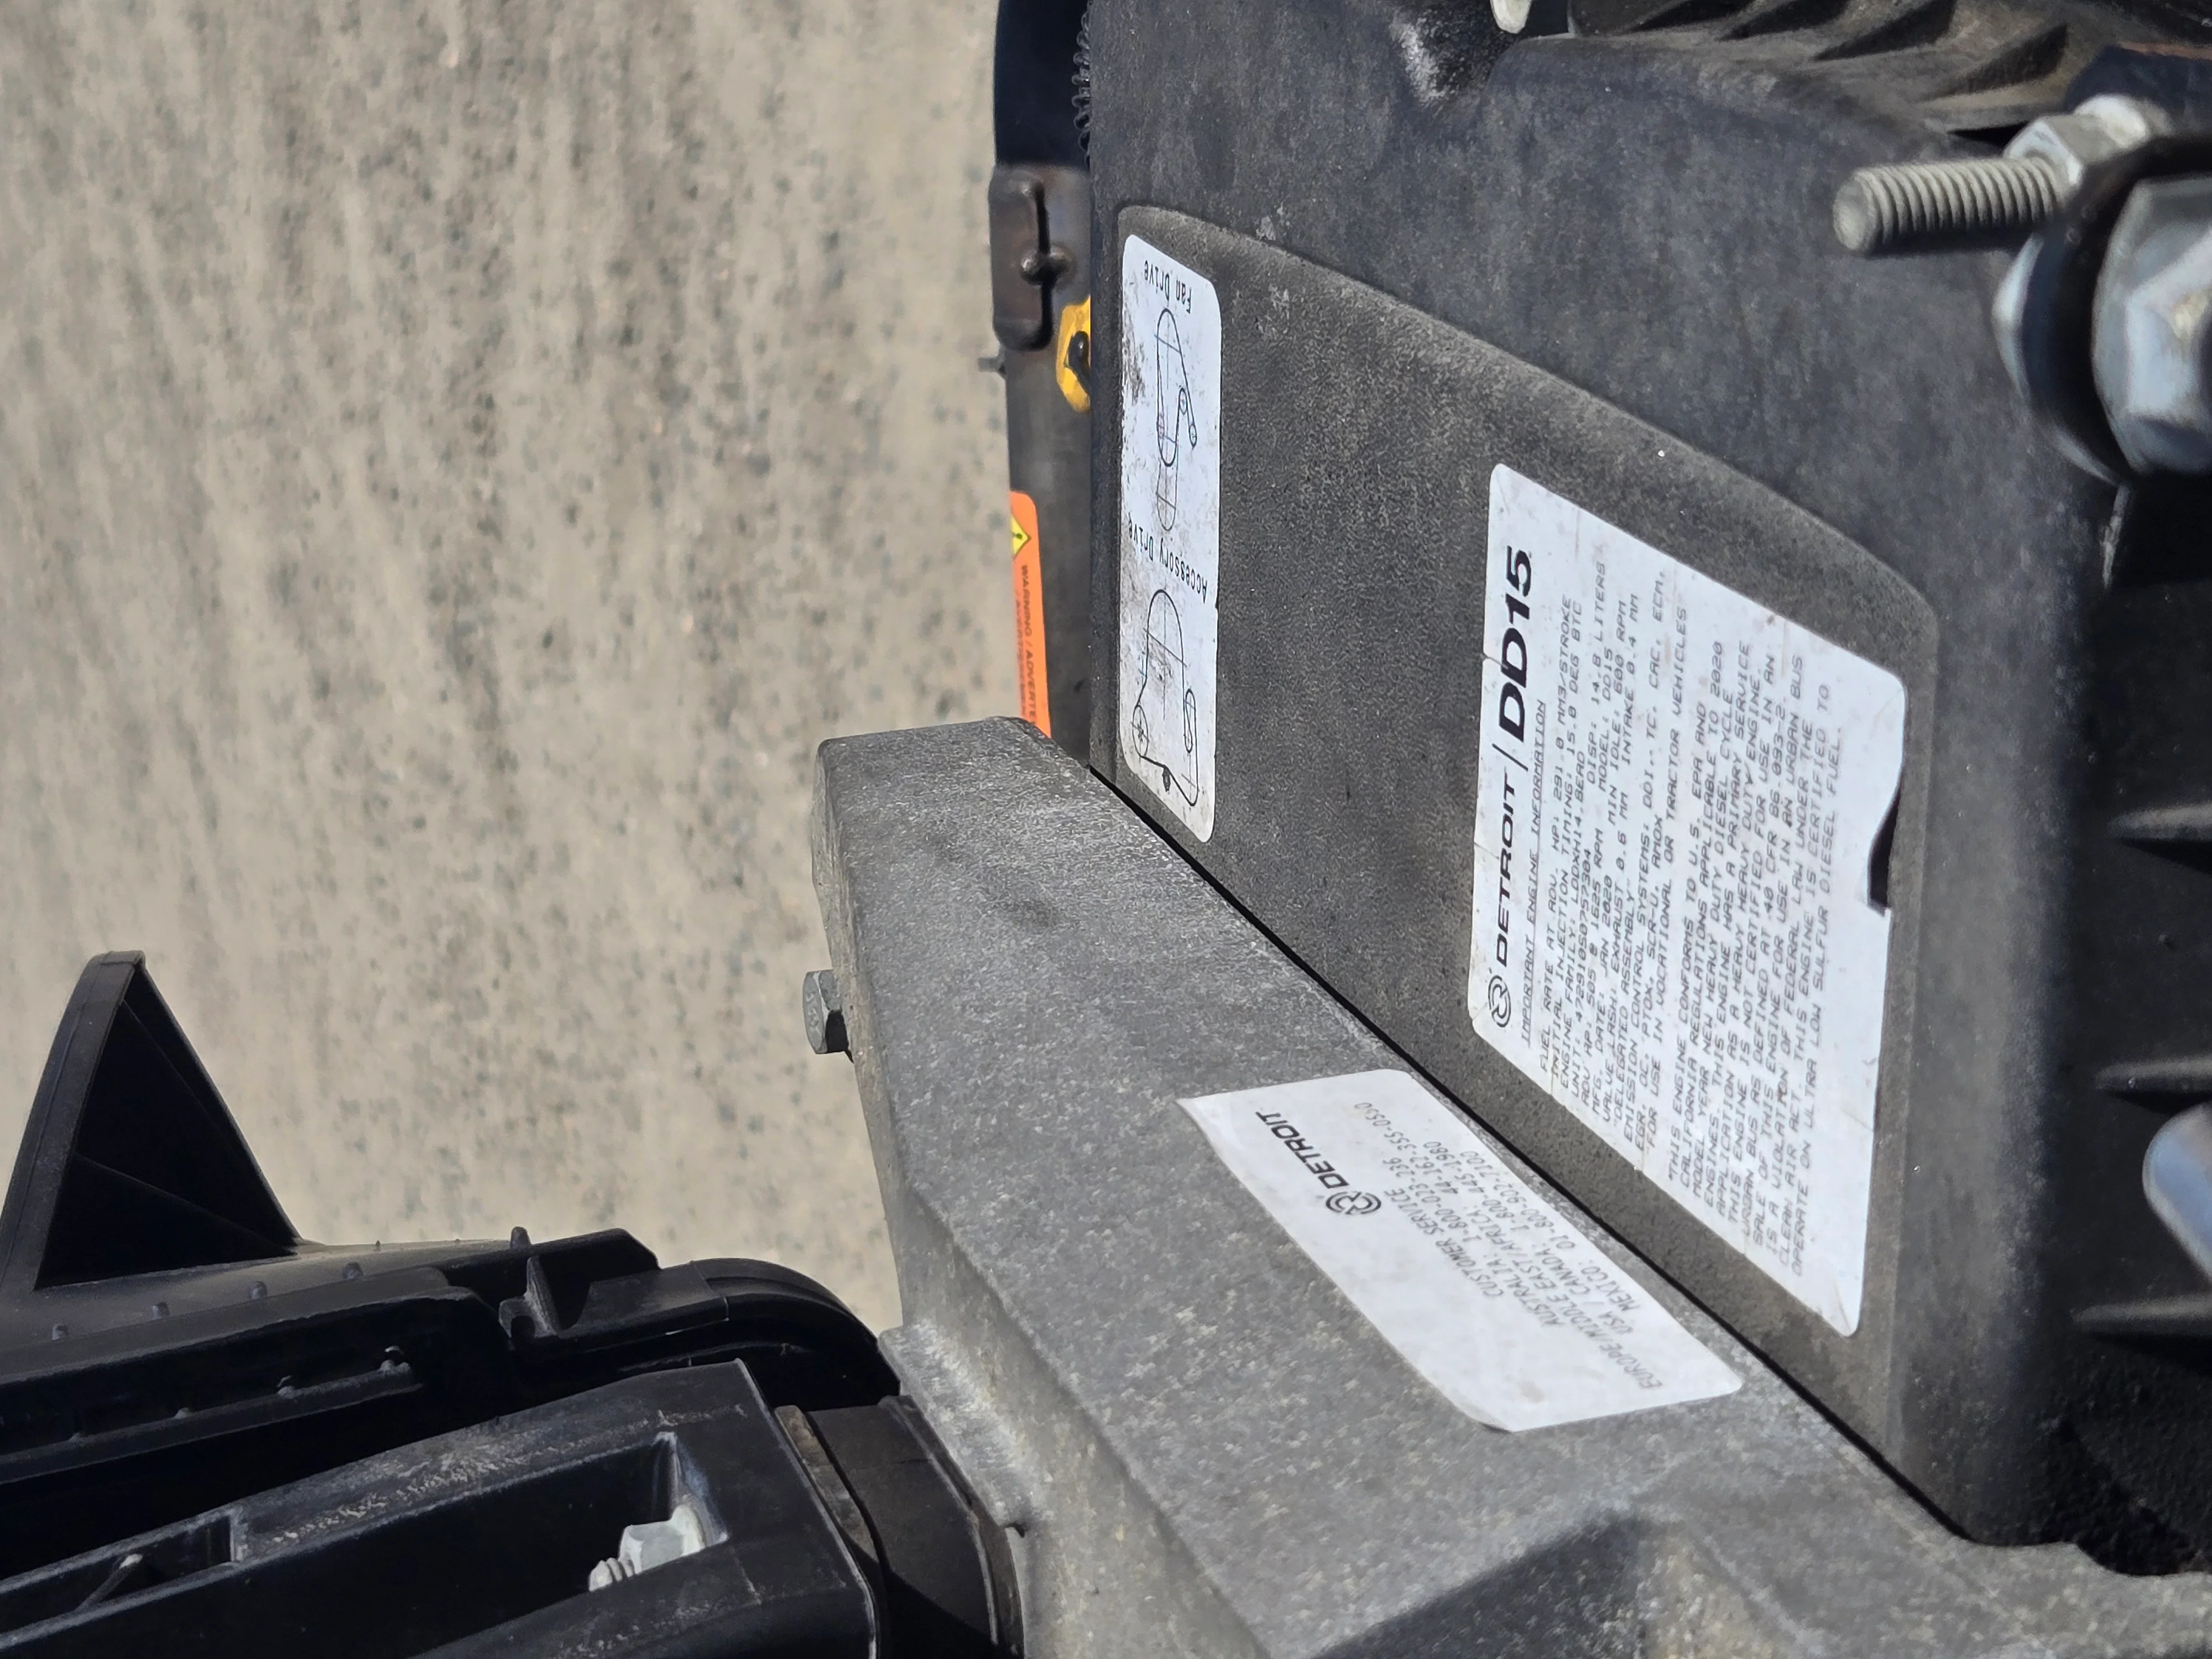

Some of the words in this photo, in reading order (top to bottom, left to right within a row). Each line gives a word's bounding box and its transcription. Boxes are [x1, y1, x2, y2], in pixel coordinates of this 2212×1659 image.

[1144, 259, 1170, 301] Drive
[1176, 279, 1192, 314] Fan
[1128, 512, 1154, 561] Drive
[1160, 538, 1207, 604] Accessory
[1022, 565, 1032, 635] WARNING
[1571, 601, 1582, 641] BTC
[1594, 561, 1605, 641] LITERS
[1499, 546, 1531, 741] DD15
[1764, 654, 1775, 685] AN
[1026, 650, 1036, 726] ADVERTE
[1568, 653, 1579, 693] DEG
[1621, 687, 1634, 764] INTAKE
[1629, 593, 1638, 622] MM
[1734, 642, 1749, 739] SERVICE
[1790, 655, 1802, 700] BUS
[1817, 684, 1829, 711] TO
[1608, 784, 1617, 825] MIN
[1616, 600, 1626, 641] RPM
[1695, 702, 1706, 745] AND
[1707, 709, 1719, 734] TO
[1719, 690, 1733, 760] CYCLE
[1761, 697, 1772, 724] IN
[1758, 739, 1770, 782] USE
[1785, 712, 1799, 785] URBAN
[1799, 719, 1812, 760] THE
[1531, 700, 1544, 834] INFORMATION
[1666, 729, 1679, 819] TRACTOR
[1691, 757, 1703, 799] EPA
[1807, 728, 1826, 856] CERTIFIED
[1699, 752, 1716, 886] APPLICABLE
[1714, 777, 1728, 855] DIESEL
[1727, 753, 1741, 849] PRIMARY
[1741, 773, 1753, 831] DUTY
[1754, 795, 1766, 838] FOR
[1782, 797, 1793, 827] AN
[1795, 776, 1808, 848] UNDER
[1496, 770, 1514, 966] DETROIT
[1593, 828, 1603, 868] RPM
[1651, 815, 1662, 869] AMOX
[1663, 835, 1673, 864] OR
[1765, 831, 1777, 873] CFR
[1780, 838, 1791, 866] IN
[1819, 812, 1835, 894] DIESEL
[1526, 849, 1537, 924] ENGINE
[1685, 878, 1697, 902] TO
[1709, 867, 1721, 923] DUTY
[1725, 861, 1735, 877] A
[1737, 843, 1749, 912] HEAVY
[1791, 861, 1803, 905] LAW
[1805, 869, 1816, 896] IS
[1555, 869, 1568, 979] INJECTION
[1723, 888, 1734, 931] HAS
[1745, 851, 1762, 974] CERTIFIED
[1776, 880, 1788, 924] USE
[1546, 923, 1554, 950] AT
[1599, 937, 1609, 977] JAN
[1603, 1060, 1614, 1122] VALVE
[1610, 884, 1623, 973] EXHAUST
[1619, 791, 1628, 820] MM
[1656, 881, 1671, 1005] VOCATIONAL
[1732, 924, 1744, 993] HEAVY
[1760, 927, 1771, 956] AT
[1772, 935, 1783, 979] FOR
[1798, 912, 1813, 996] ENGINE
[1813, 906, 1828, 990] SULFUR
[1521, 935, 1533, 1041] IMPORTANT
[1543, 960, 1553, 1011] RATE
[1630, 942, 1644, 1028] CONTROL
[1678, 917, 1693, 1023] CONFORMS
[1689, 899, 1707, 1045] REGULATIONS
[1705, 934, 1717, 1002] HEAVY
[1716, 943, 1730, 1024] ENGINE
[1783, 924, 1799, 1015] FEDERAL
[1653, 1016, 1663, 1043] IN
[1702, 1013, 1713, 1055] NEW
[1729, 1004, 1739, 1020] A
[1743, 986, 1753, 1029] NOT
[1752, 969, 1768, 1064] DEFINED
[1765, 990, 1780, 1073] ENGINE
[1809, 1003, 1821, 1047] LOW
[1540, 1026, 1550, 1072] FUEL
[1551, 998, 1562, 1078] INITIAL
[1560, 1014, 1572, 1088] ENGINE
[1712, 1035, 1724, 1086] THIS
[1726, 1030, 1738, 1060] AS
[1739, 1039, 1750, 1066] IS
[1780, 1026, 1791, 1056] OF
[1793, 1008, 1807, 1061] THIS
[1624, 1039, 1637, 1141] EMISSION
[1650, 1056, 1660, 1097] USE
[1672, 1036, 1686, 1114] ENGINE
[1698, 1066, 1709, 1115] YEAR
[1750, 1074, 1761, 1105] AS
[1804, 1058, 1817, 1128] ULTRA
[1680, 1057, 1697, 1187] CALIFORNIA
[1733, 1080, 1747, 1161] ENGINE
[1746, 1115, 1758, 1158] BUS
[1760, 1084, 1773, 1139] THIS
[1256, 1113, 1348, 1188] DETROIT
[1692, 1138, 1704, 1197] MODEL
[1716, 1071, 1734, 1215] APPLICATION
[1757, 1151, 1768, 1180] OF
[1785, 1144, 1797, 1187] AIR
[1800, 1140, 1811, 1169] ON
[1384, 1188, 1444, 1234] SERVICE
[1728, 1171, 1741, 1223] THIS
[1752, 1192, 1766, 1245] SALE
[1768, 1201, 1778, 1218] A
[1766, 1227, 1777, 1255] IS
[1791, 1181, 1808, 1276] OPERATE
[1435, 1238, 1503, 1297] CUSTOMER
[1597, 1311, 1633, 1334] USA
